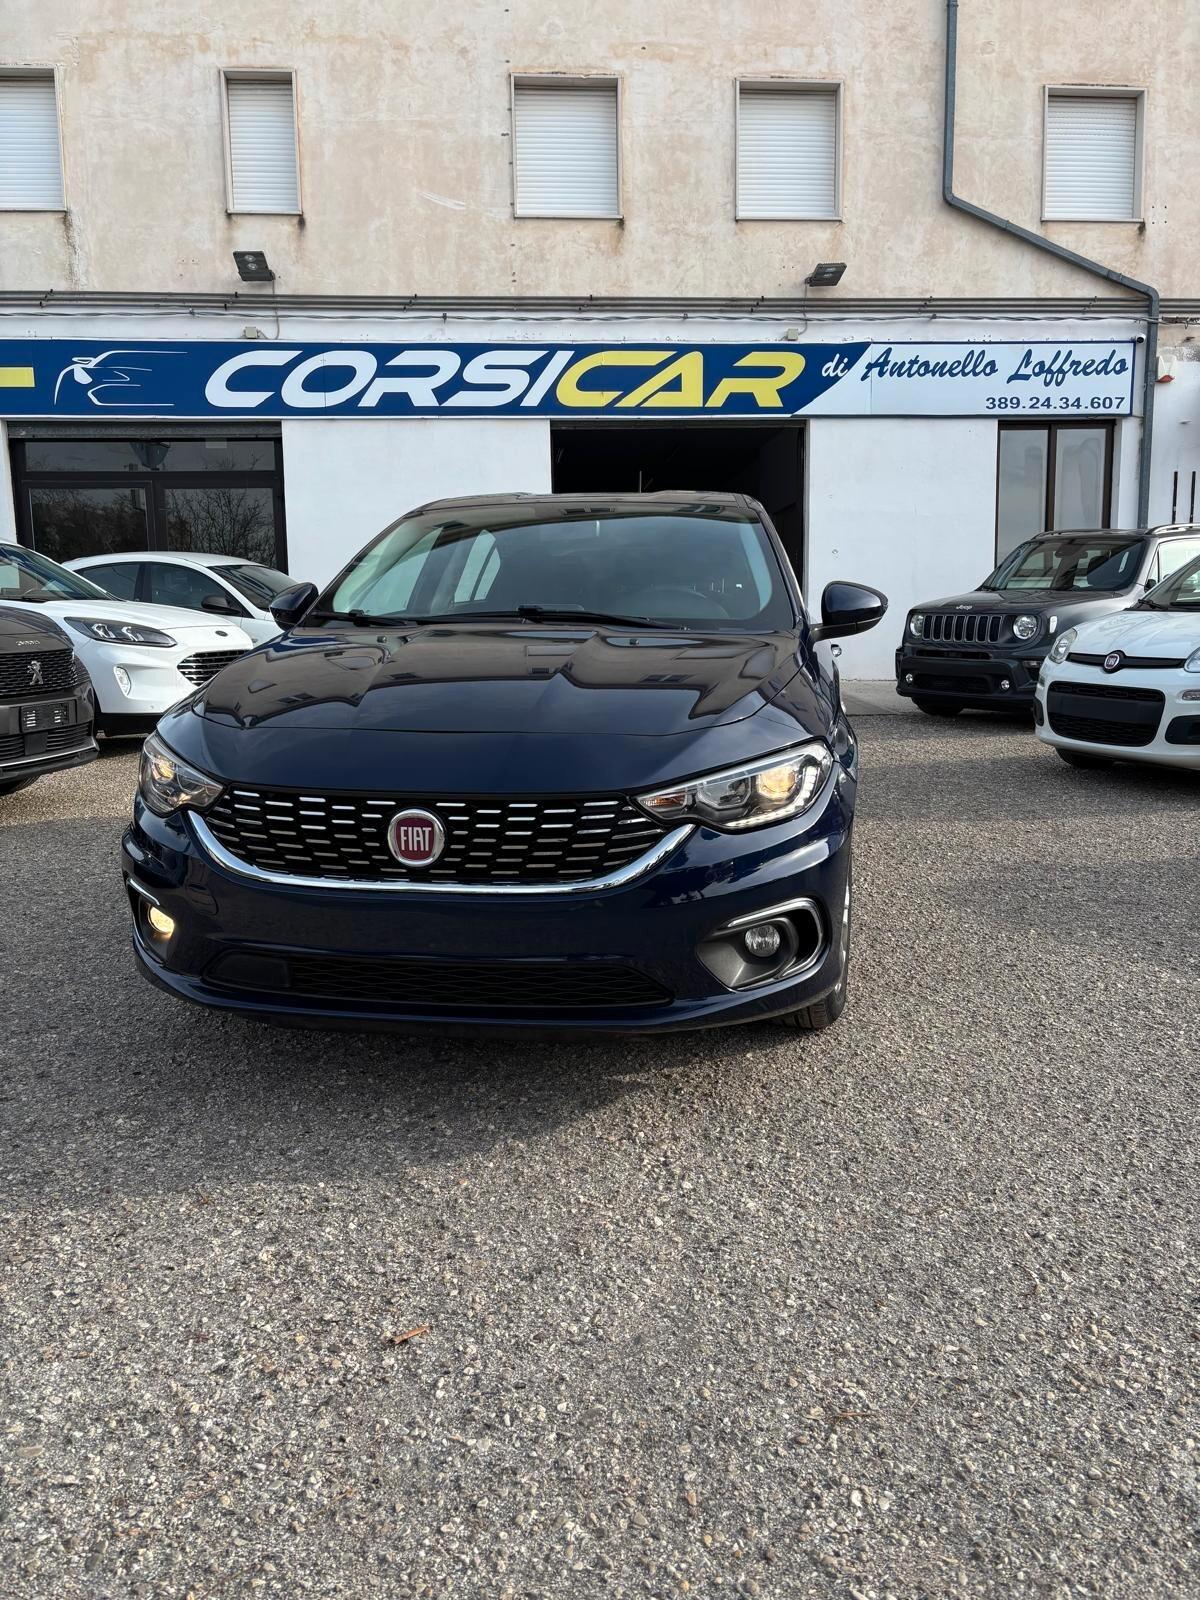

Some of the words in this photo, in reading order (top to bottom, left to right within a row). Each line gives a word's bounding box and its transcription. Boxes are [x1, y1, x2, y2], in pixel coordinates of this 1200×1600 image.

[204, 350, 806, 408] CORSICAR
[821, 353, 849, 378] di
[860, 347, 999, 382] Antonello
[1006, 348, 1129, 387] Loffredo
[985, 396, 1125, 410] 389.24.34.607
[400, 826, 432, 851] FIAT
